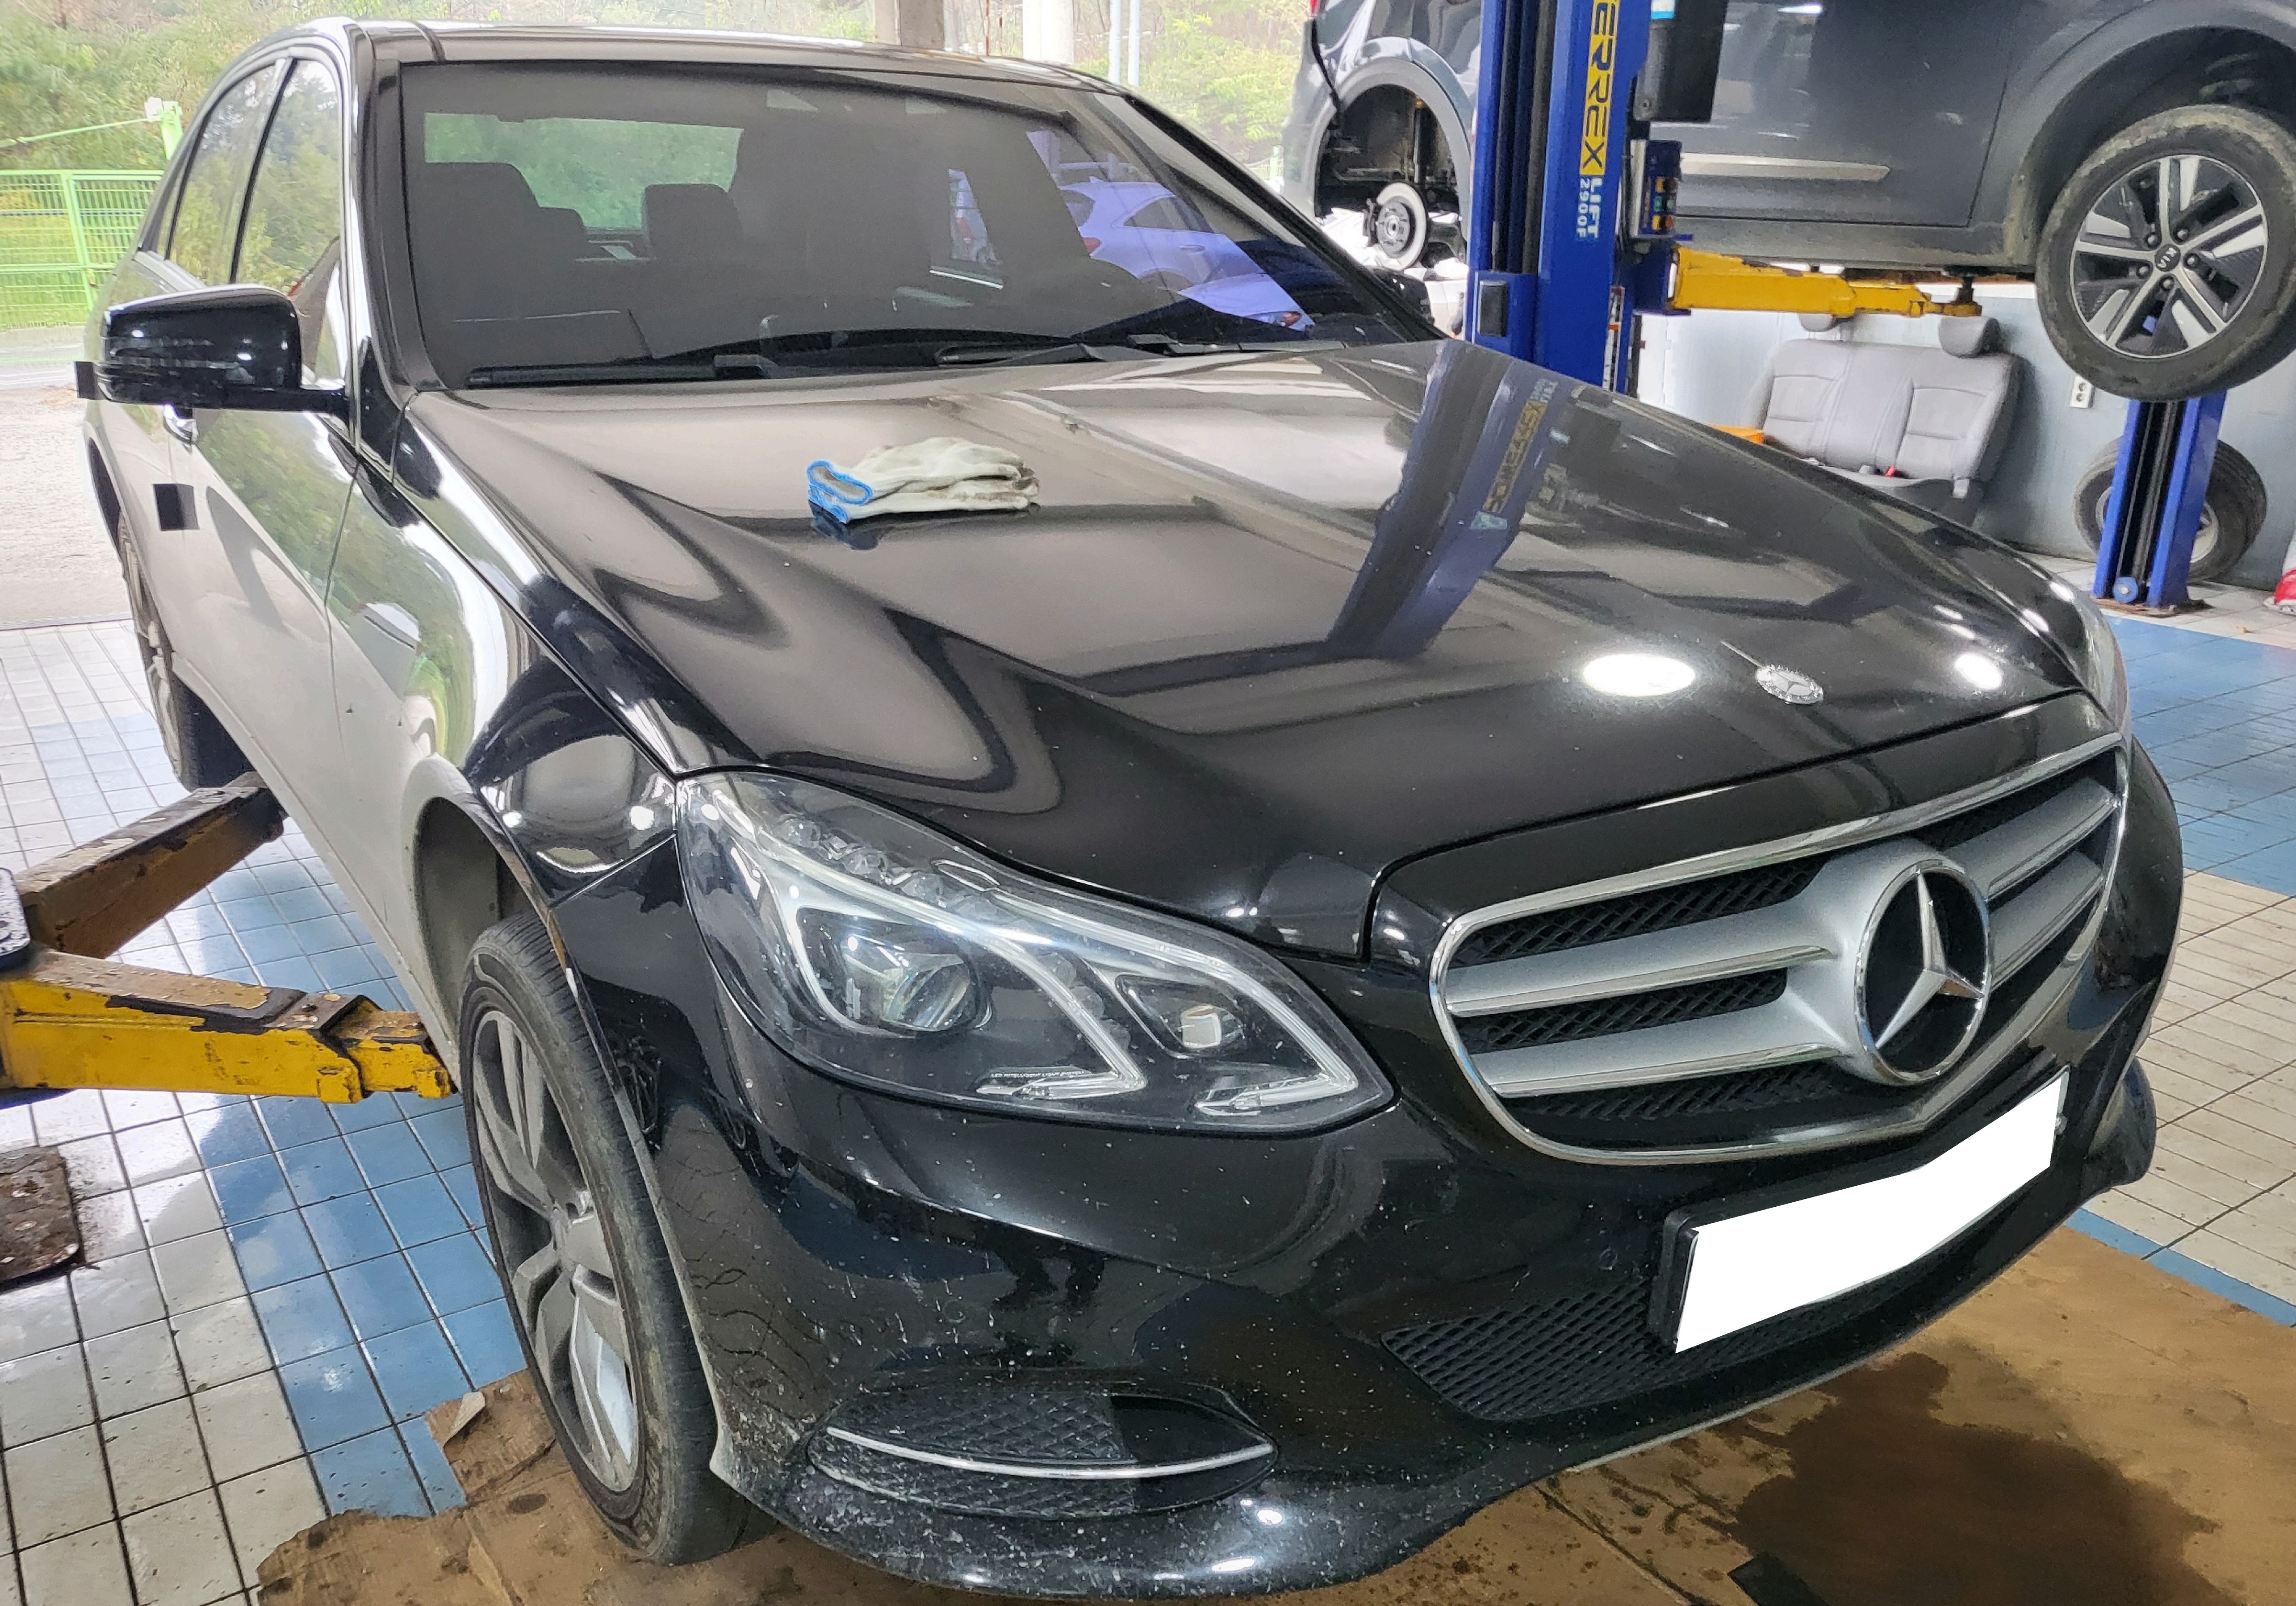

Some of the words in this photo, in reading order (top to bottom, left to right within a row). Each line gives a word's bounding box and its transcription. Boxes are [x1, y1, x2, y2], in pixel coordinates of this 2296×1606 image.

[1582, 0, 1616, 169] ERREX
[1577, 177, 1590, 238] 2900F
[1588, 177, 1603, 239] LIFT
[2157, 247, 2177, 268] KIA
